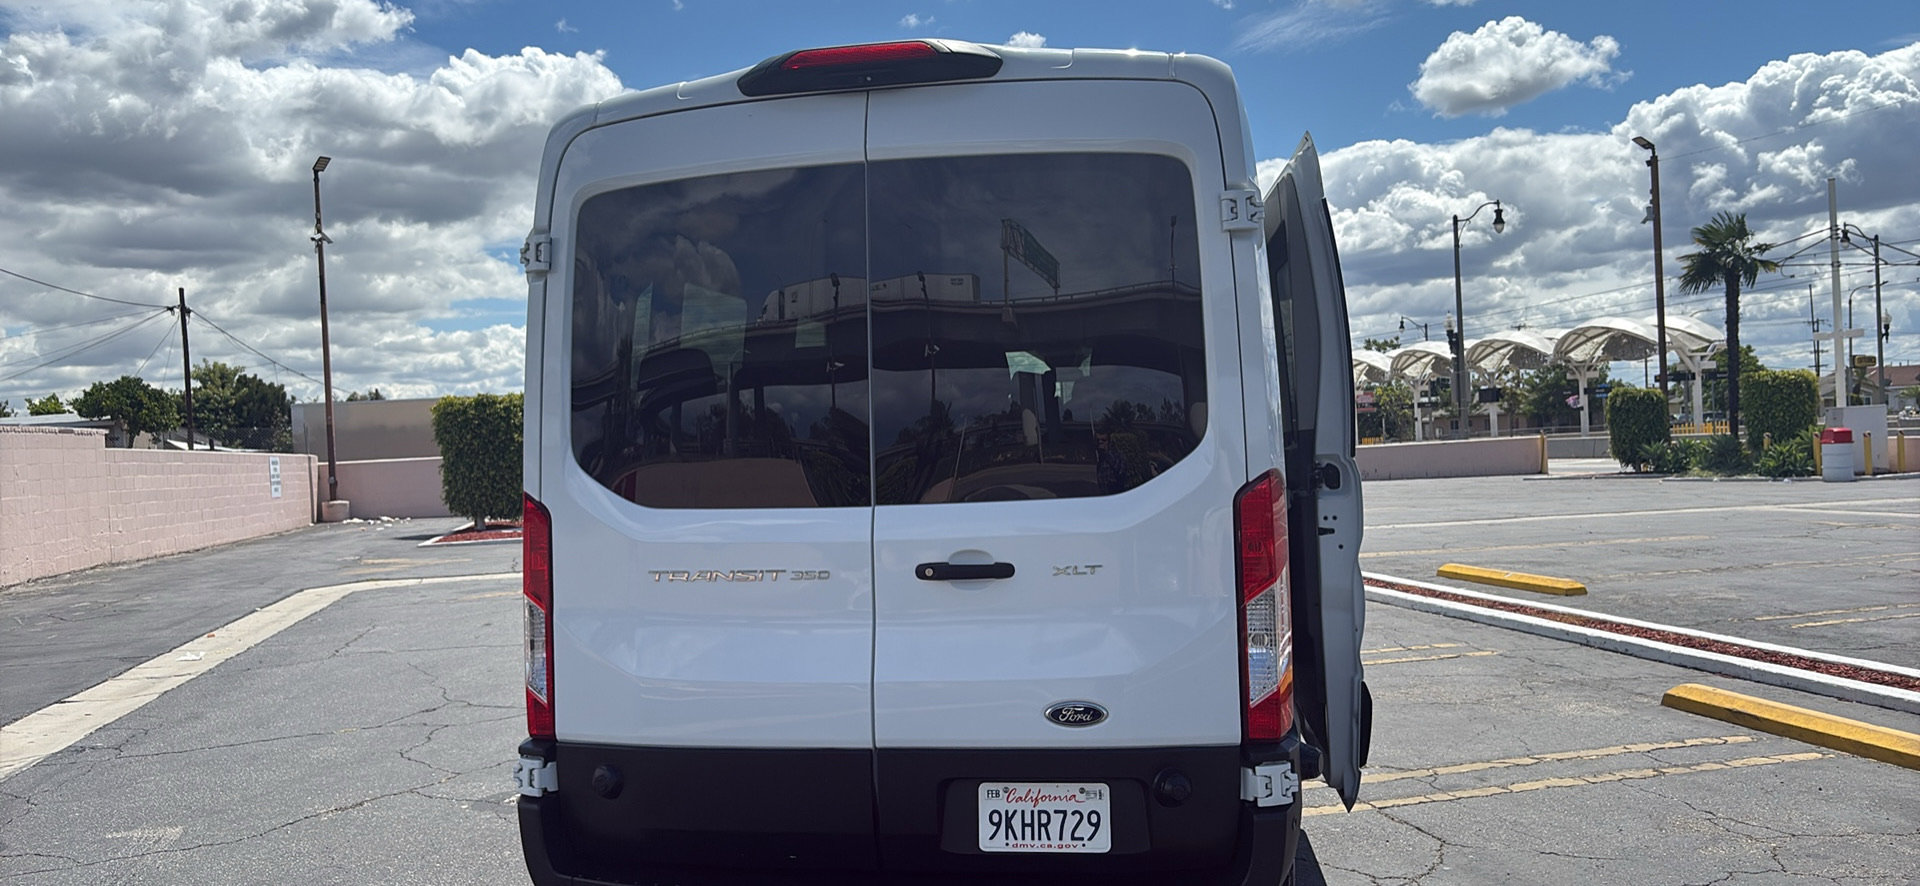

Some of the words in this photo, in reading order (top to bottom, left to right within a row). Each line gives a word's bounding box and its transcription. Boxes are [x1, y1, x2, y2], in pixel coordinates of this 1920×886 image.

[648, 569, 786, 582] TRANSIT
[790, 570, 831, 581] 350
[1052, 565, 1103, 576] XLT
[1058, 707, 1093, 721] Ford
[986, 789, 1001, 799] FEB
[1005, 787, 1086, 808] California
[988, 809, 1102, 842] 9KHR729
